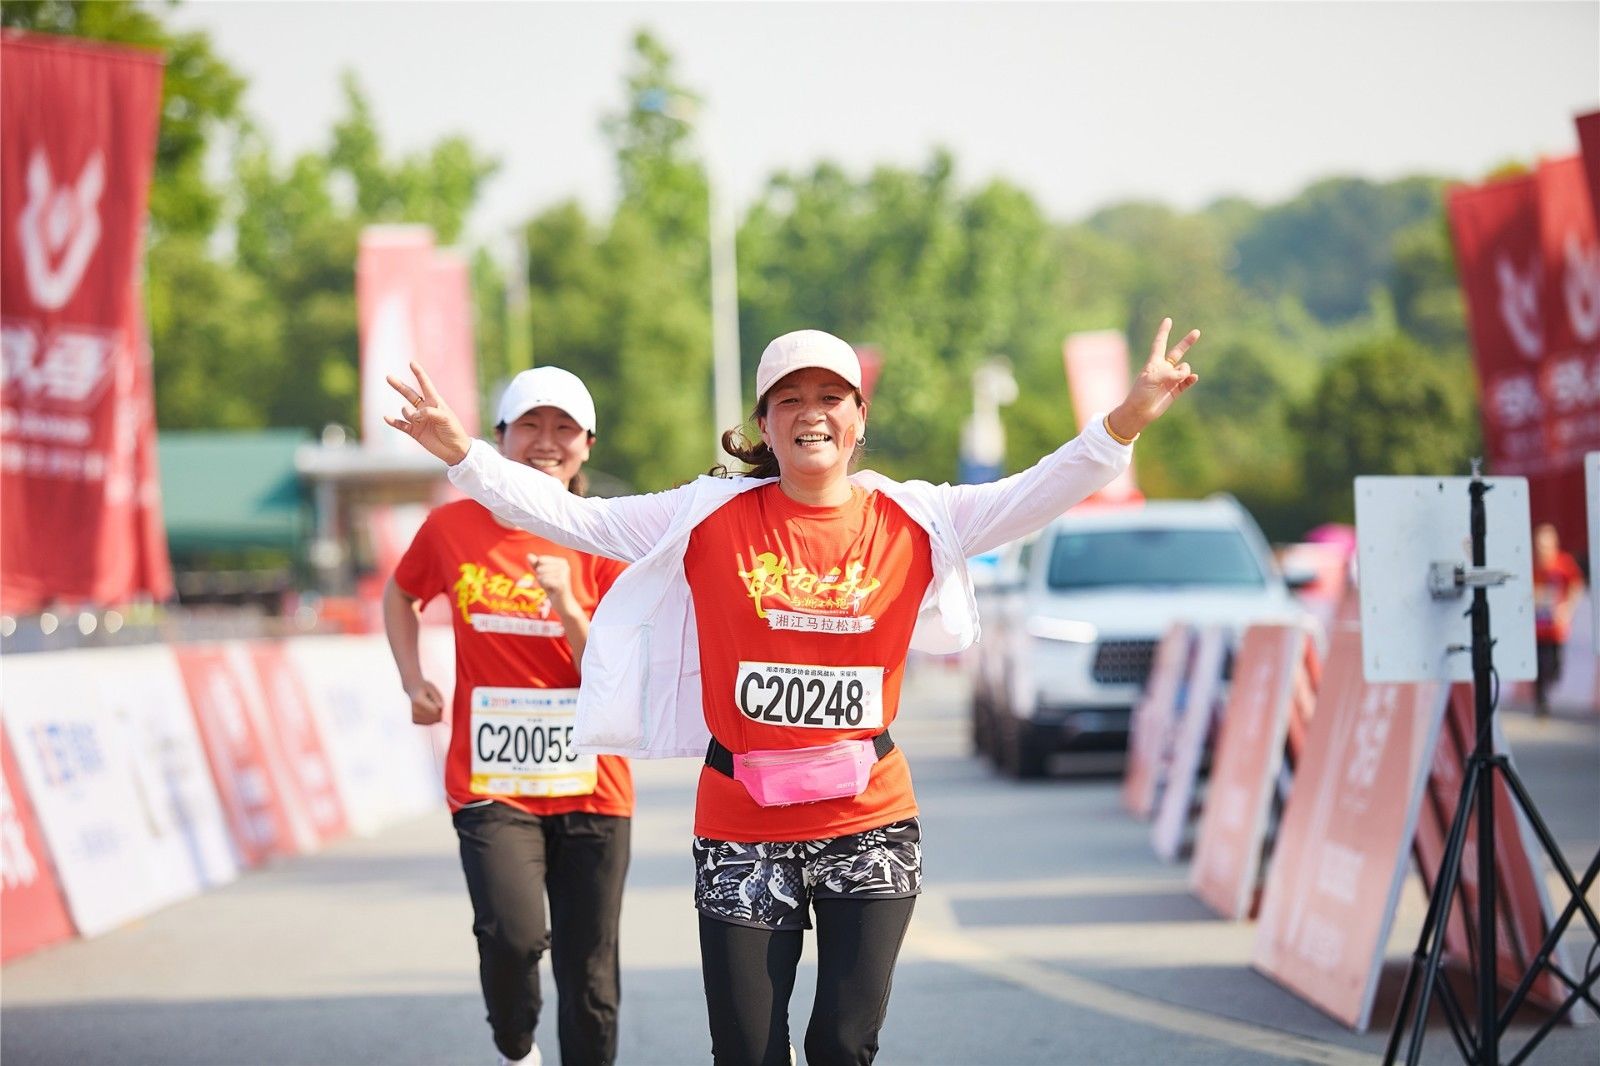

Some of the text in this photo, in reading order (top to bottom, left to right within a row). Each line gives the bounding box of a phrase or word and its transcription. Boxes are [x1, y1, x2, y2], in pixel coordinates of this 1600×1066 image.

[775, 613, 863, 632] 湘江马拉松赛
[740, 671, 864, 726] C20248
